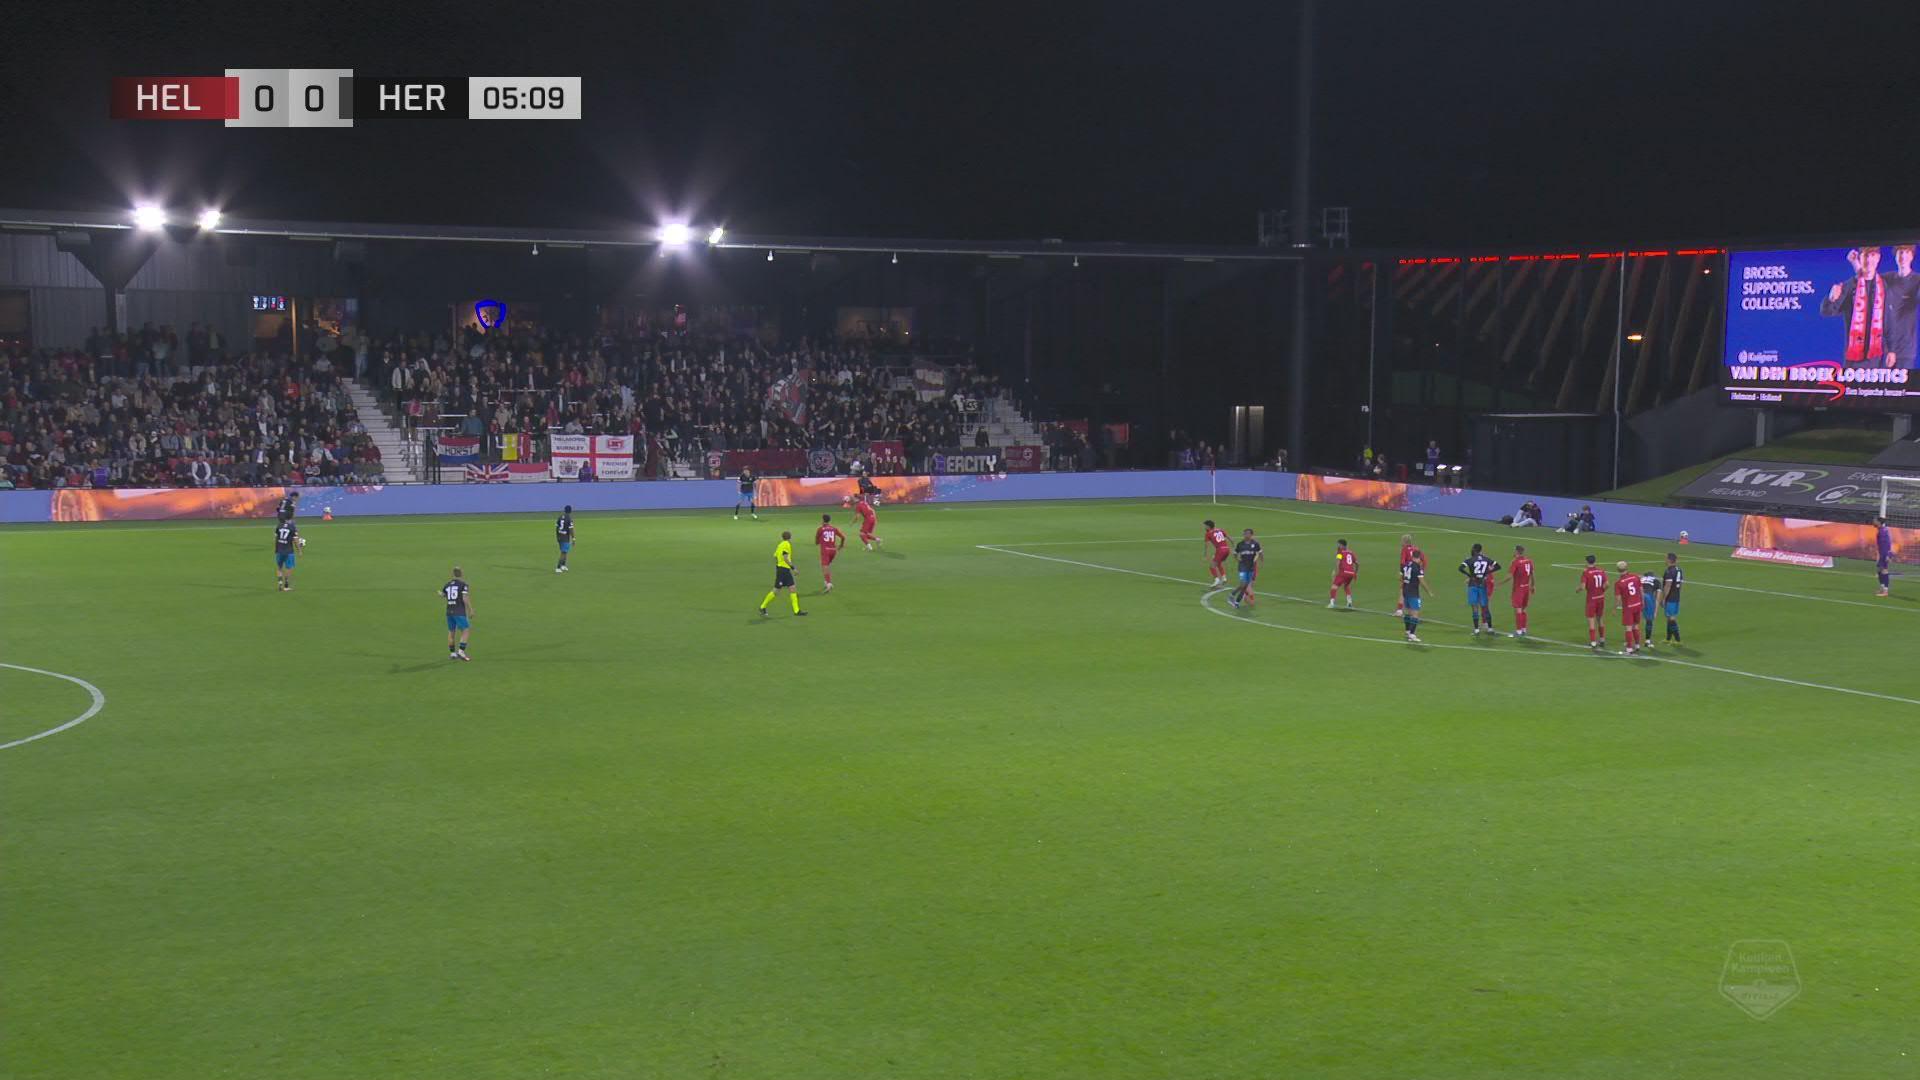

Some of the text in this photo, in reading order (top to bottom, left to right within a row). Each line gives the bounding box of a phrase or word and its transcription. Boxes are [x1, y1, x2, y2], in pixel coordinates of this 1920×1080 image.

[1743, 266, 1788, 280] BROERS.
[1742, 281, 1815, 295] SUPPORTERS.
[1741, 297, 1802, 310] COLLEGA'S.
[1730, 366, 1908, 383] VAN DEN BROEK LOGISTICS
[1720, 468, 1806, 487] KvR
[279, 528, 290, 540] 17
[823, 530, 835, 542] 34
[1473, 561, 1488, 574] 27
[1593, 574, 1603, 588] 11
[1627, 581, 1636, 596] 5
